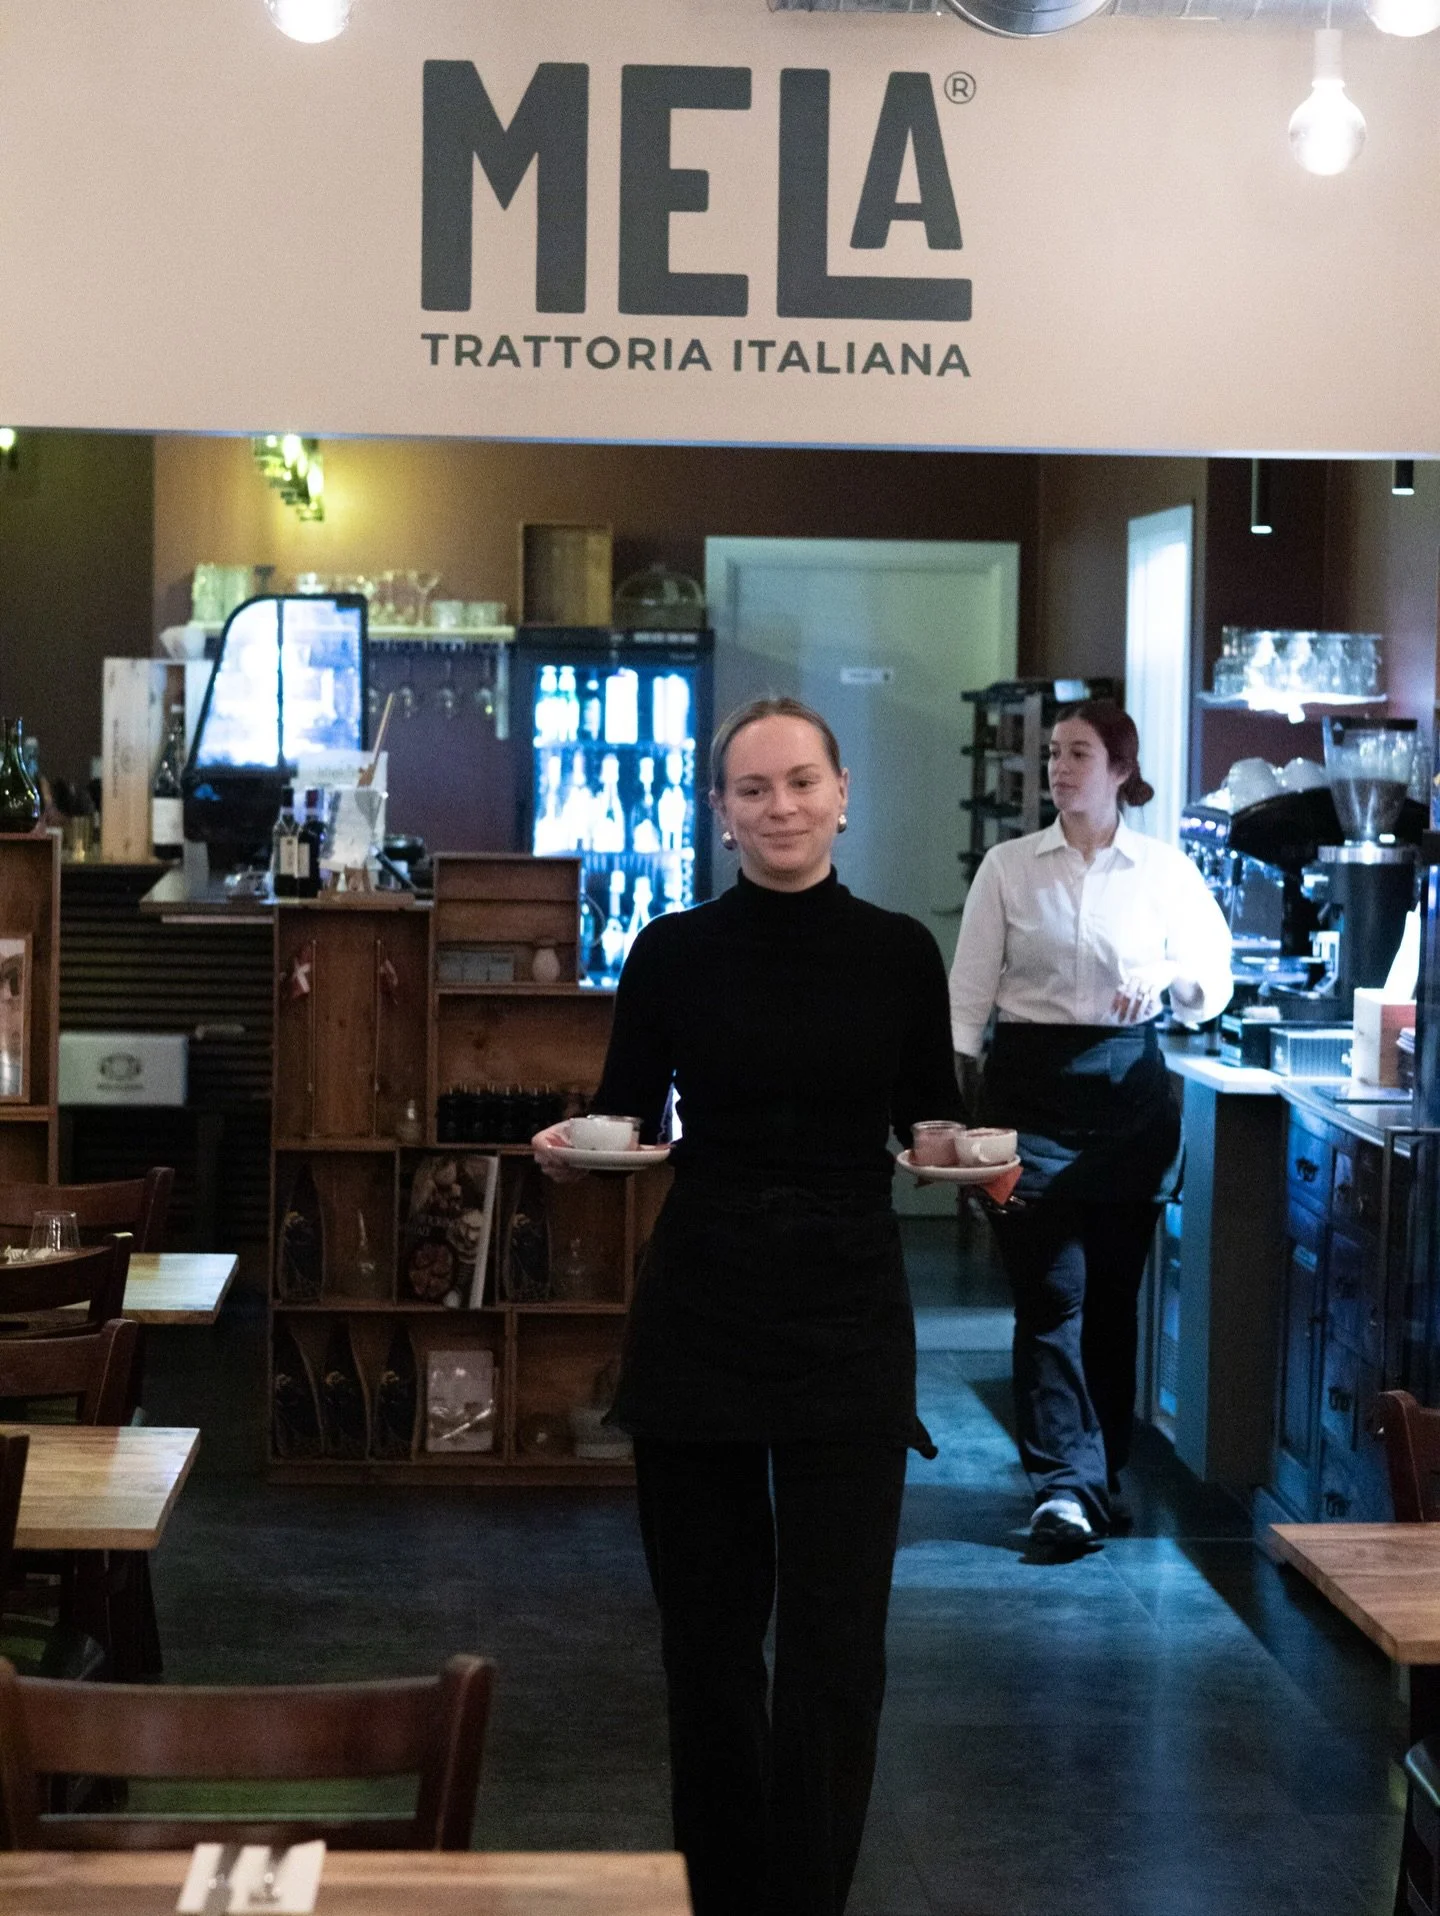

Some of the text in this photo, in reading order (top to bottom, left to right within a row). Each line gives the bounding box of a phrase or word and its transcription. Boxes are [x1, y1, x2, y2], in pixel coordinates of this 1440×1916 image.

[421, 59, 973, 322] MELA
[421, 333, 971, 377] TRATTORIA ITALIANA
